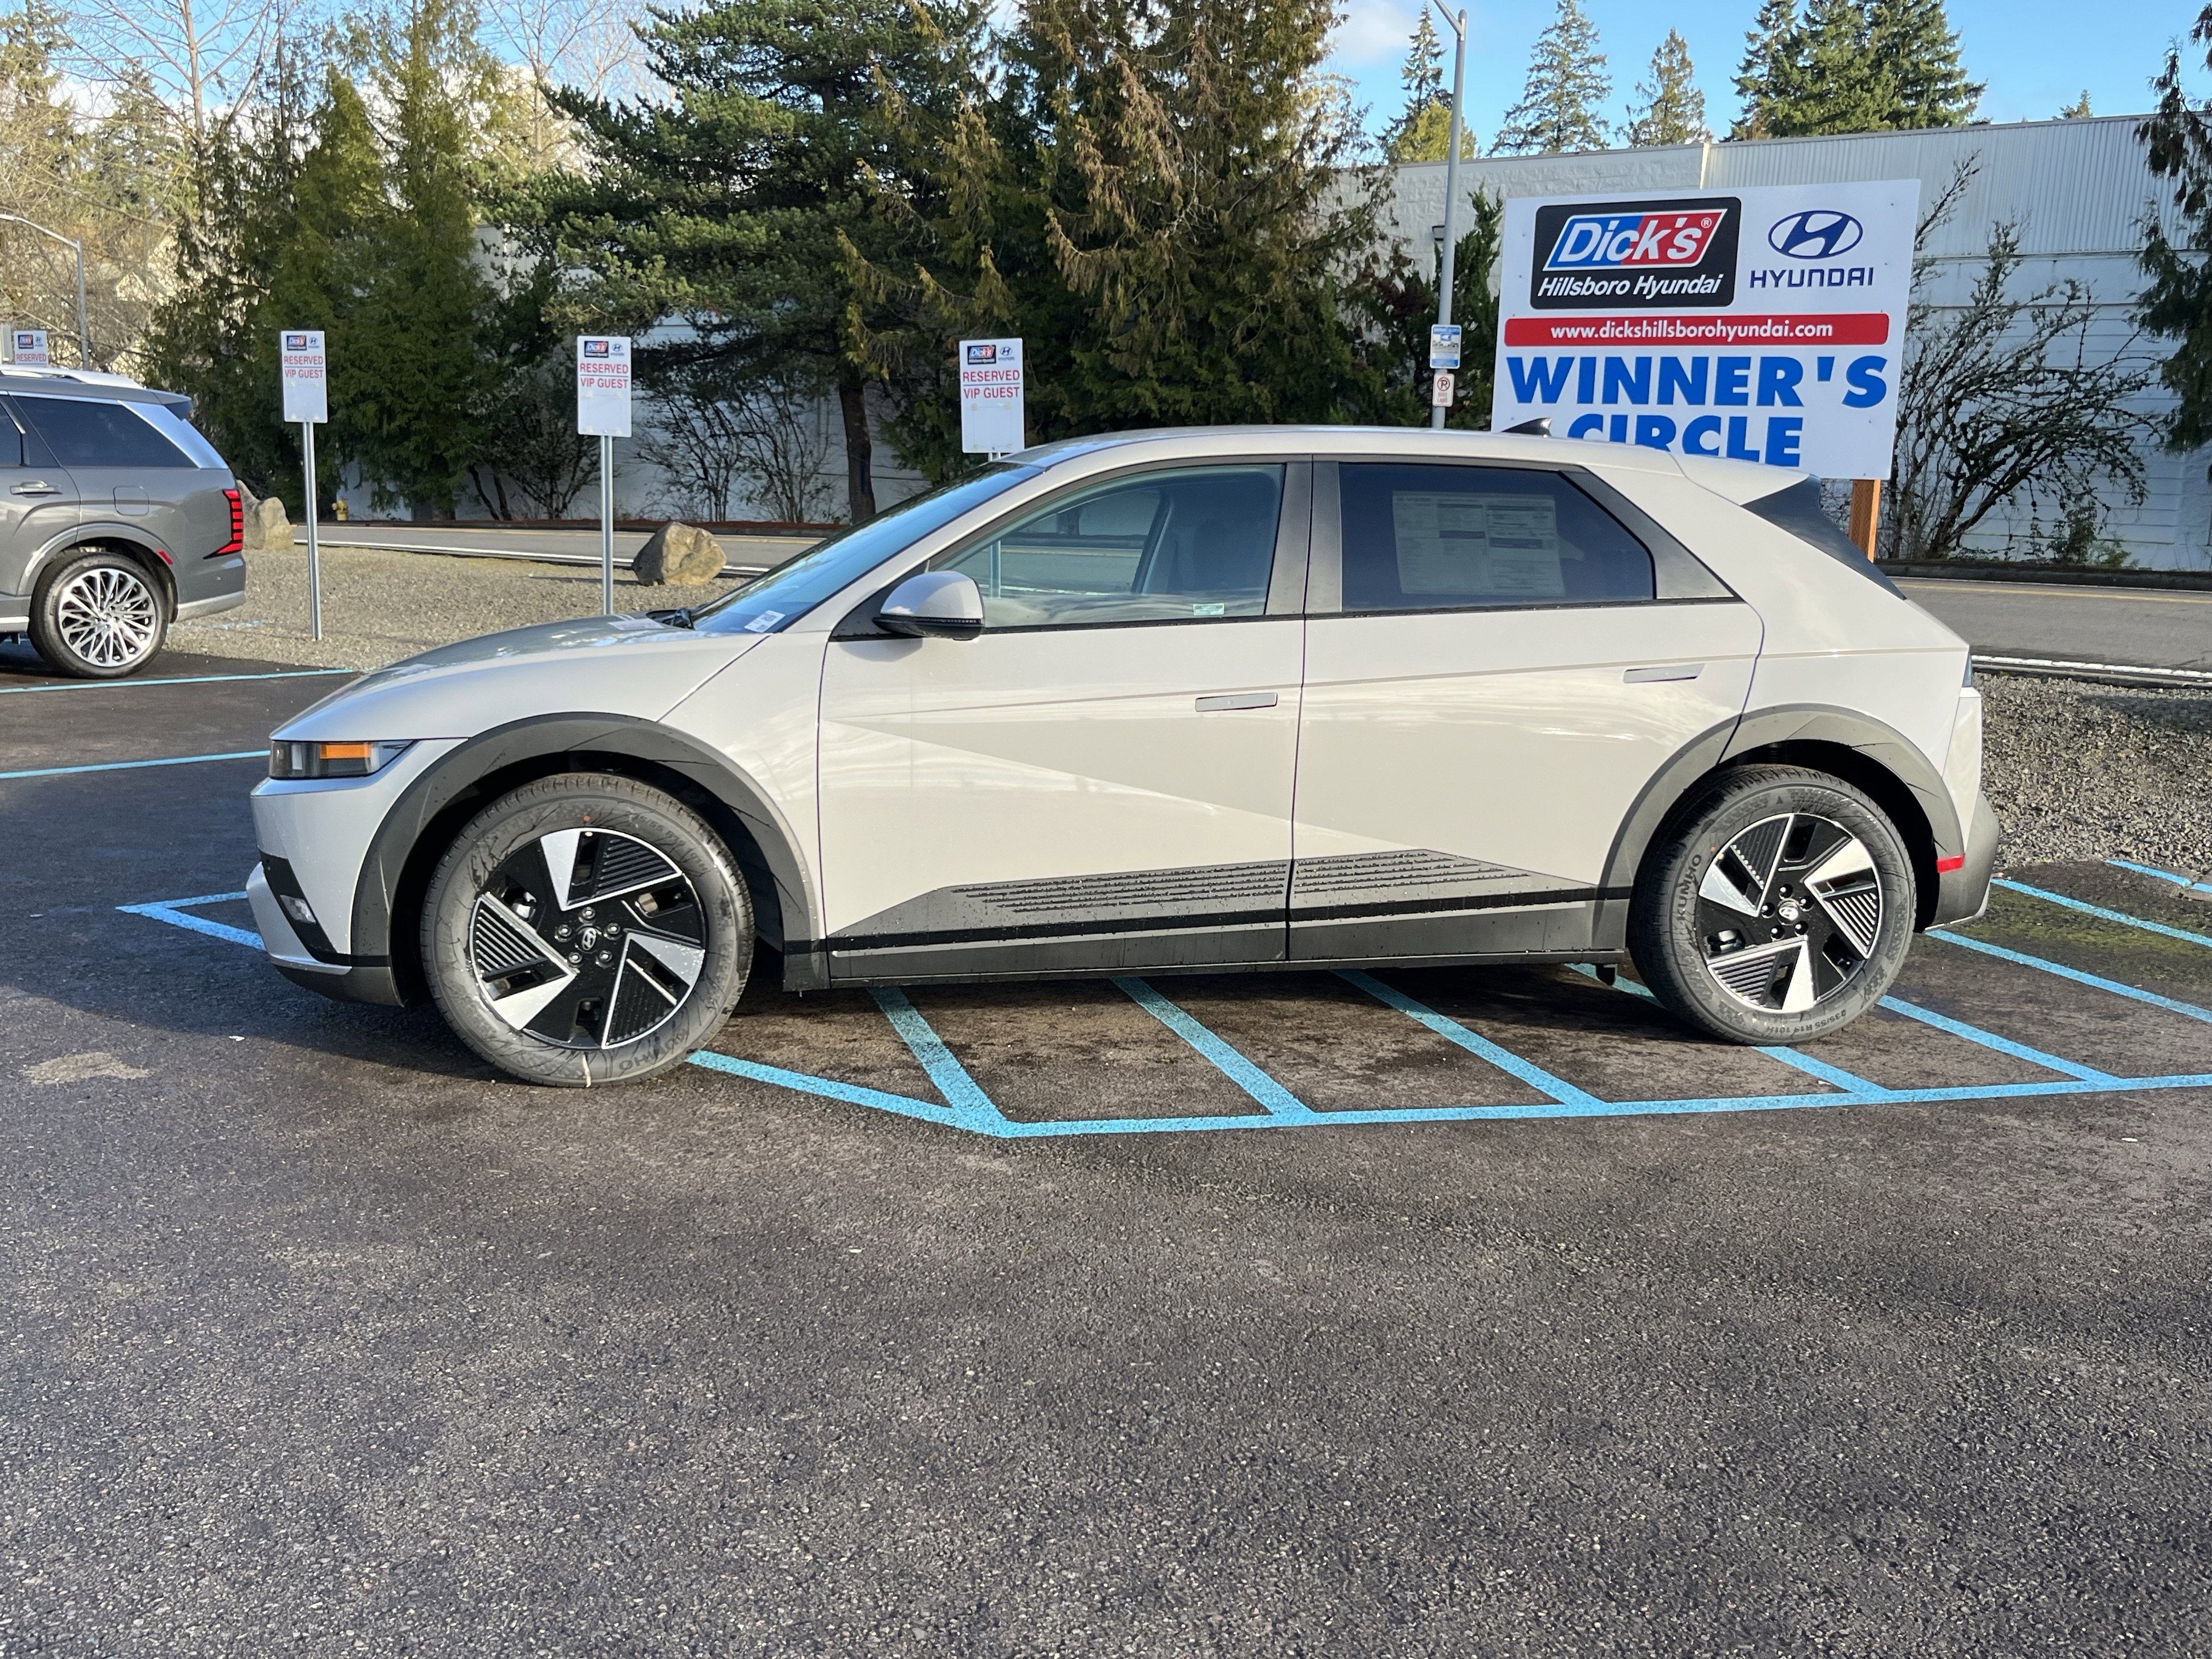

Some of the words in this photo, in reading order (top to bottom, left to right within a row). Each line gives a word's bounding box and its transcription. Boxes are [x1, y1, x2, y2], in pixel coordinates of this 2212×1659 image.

[1557, 217, 1702, 262] Dick's
[1750, 267, 1874, 288] HYUNDAI
[1537, 276, 1630, 297] Hillsboro
[1633, 273, 1725, 300] Hyundai
[1550, 318, 1833, 342] www.dickshillsborohyundai.com
[16, 353, 47, 362] RESERVED
[284, 356, 323, 365] RESERVED
[284, 369, 297, 378] VIP
[298, 369, 324, 379] GUEST
[579, 363, 629, 374] RESERVED
[962, 369, 1020, 382] RESERVED
[1506, 356, 1888, 408] WINNER'S
[580, 377, 595, 387] VIP
[597, 378, 629, 388] GUEST
[963, 388, 980, 399] VIP
[983, 387, 1020, 398] GUEST
[1677, 854, 1701, 921] KUMHO
